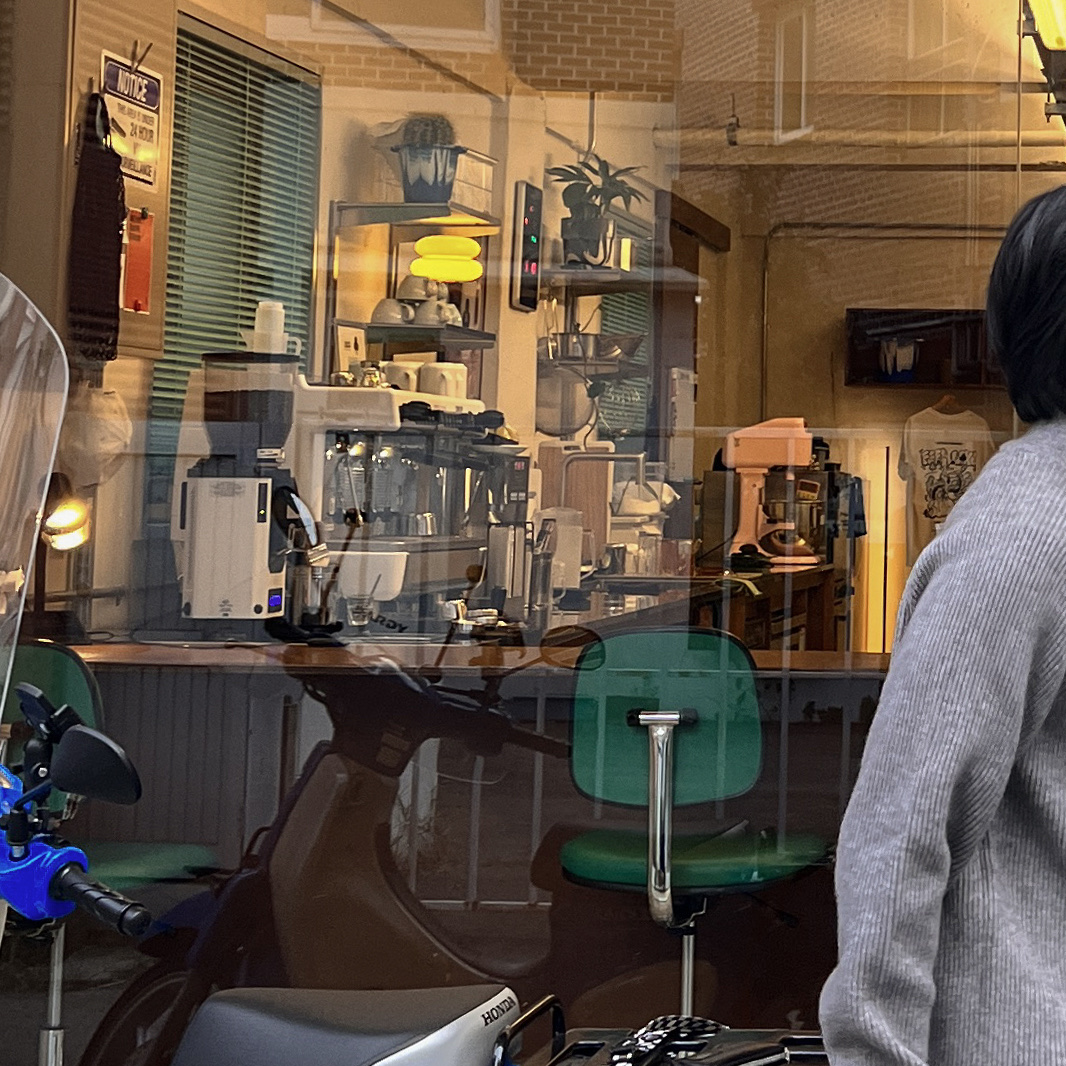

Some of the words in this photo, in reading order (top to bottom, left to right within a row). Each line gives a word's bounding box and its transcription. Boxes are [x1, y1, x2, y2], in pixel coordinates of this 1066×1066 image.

[117, 68, 149, 103] NOTICE
[130, 122, 138, 138] 24
[138, 125, 154, 144] HOUR
[481, 996, 516, 1026] HONDA
